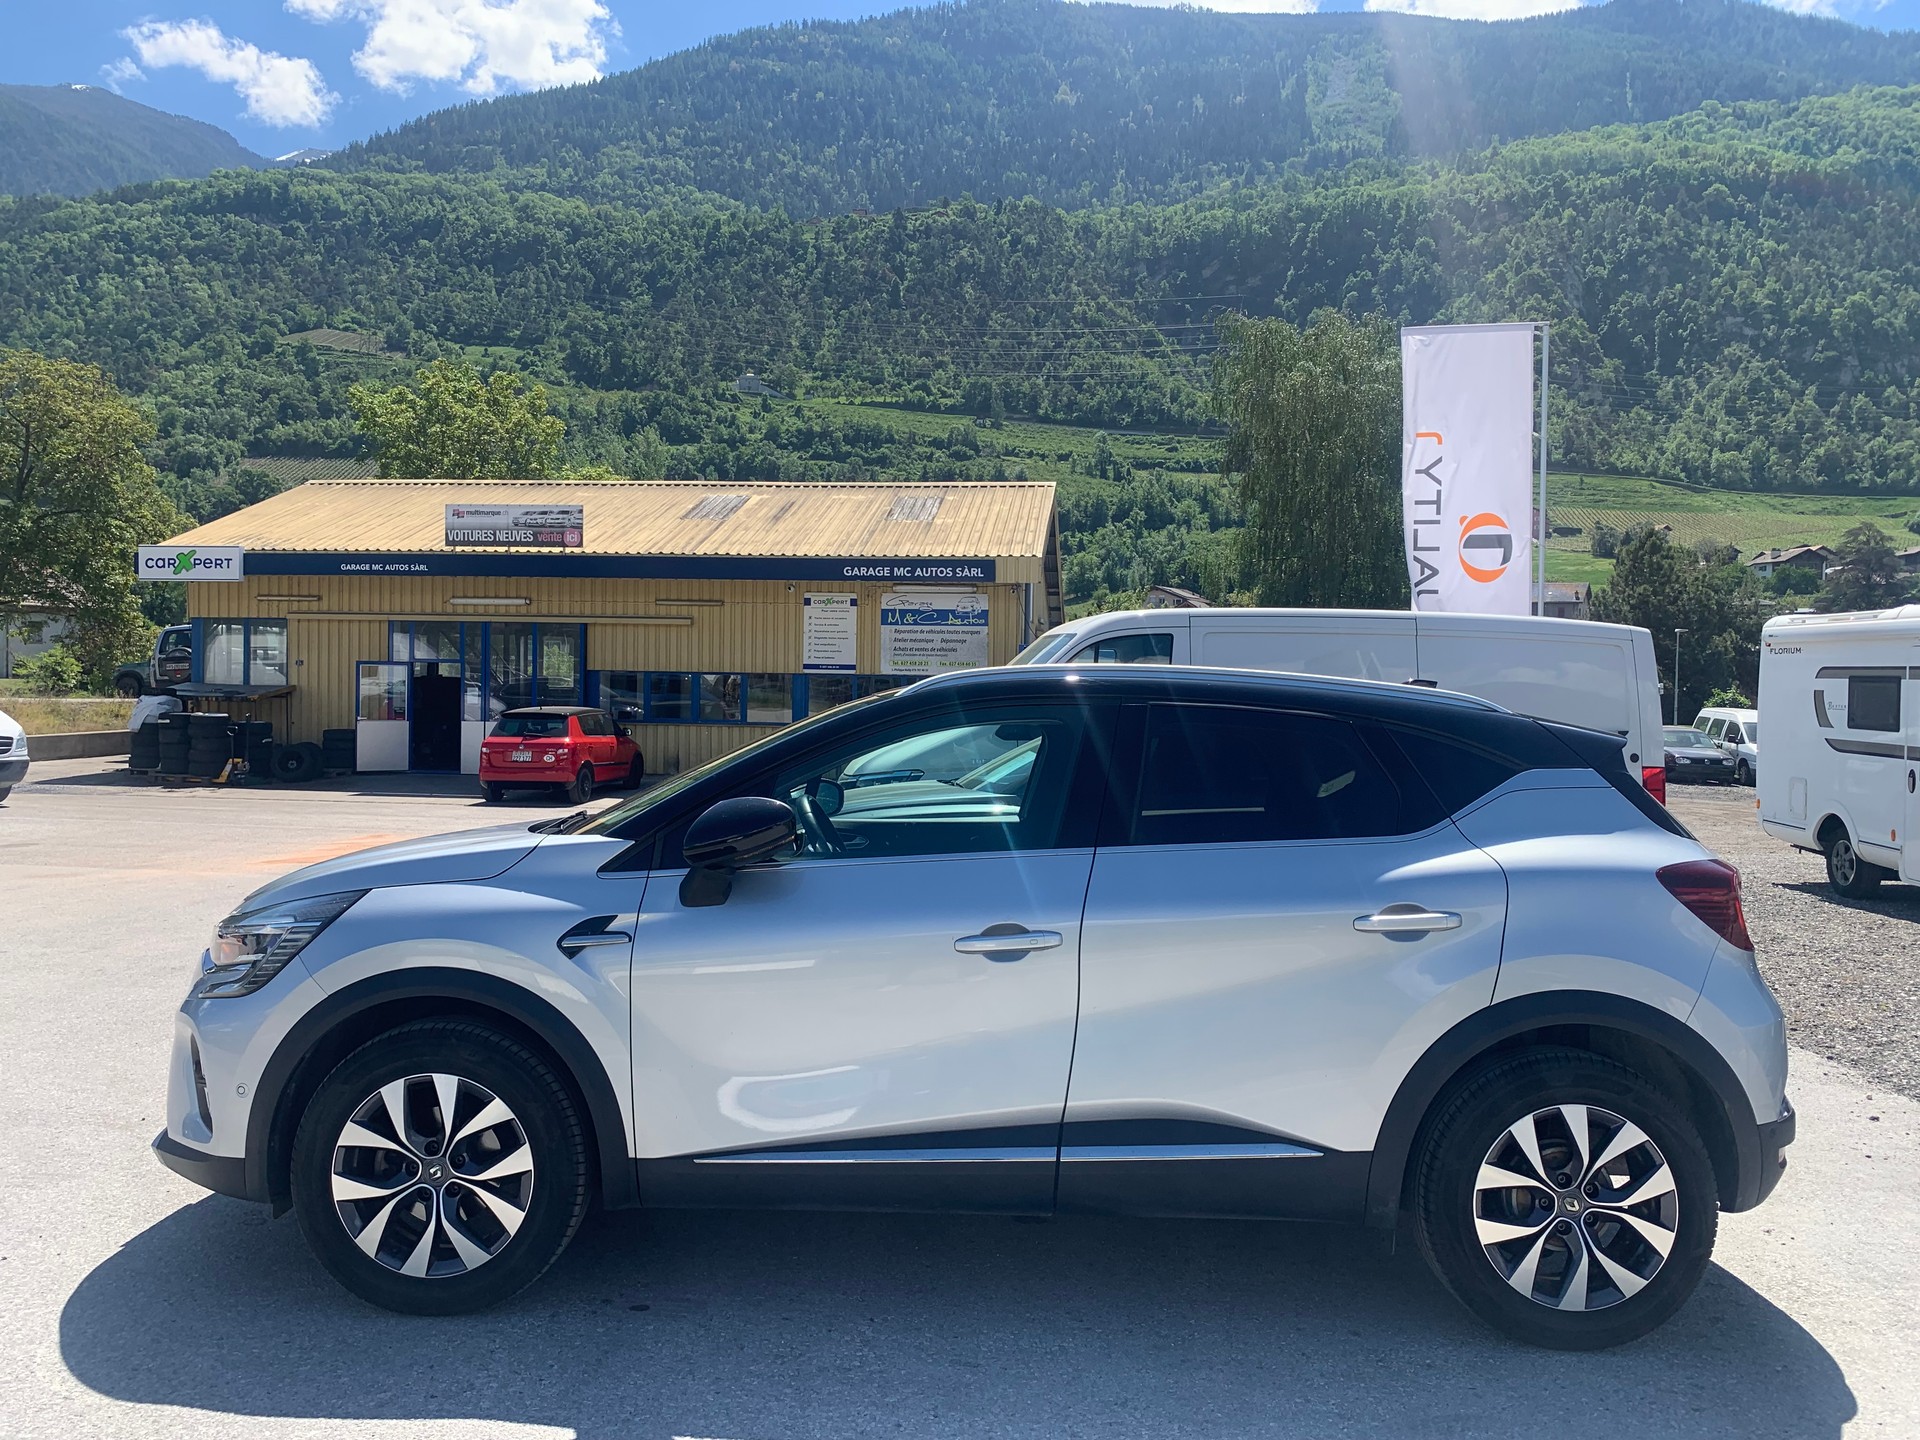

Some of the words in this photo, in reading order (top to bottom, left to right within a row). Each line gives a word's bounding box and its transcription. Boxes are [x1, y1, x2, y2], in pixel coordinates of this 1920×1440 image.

[448, 530, 491, 542] VOITURES
[496, 530, 534, 542] NEUVES
[538, 532, 562, 542] vente
[567, 531, 578, 542] ici
[340, 563, 370, 571] GARAGE
[843, 567, 890, 576] GARAGE
[894, 567, 911, 577] MC
[914, 567, 952, 577] AUTOS
[956, 566, 984, 577] SÀRL
[888, 607, 901, 625] M
[904, 613, 918, 624] &
[916, 612, 942, 624] C
[941, 613, 985, 625] Autos
[1770, 647, 1801, 655] FLORIUM
